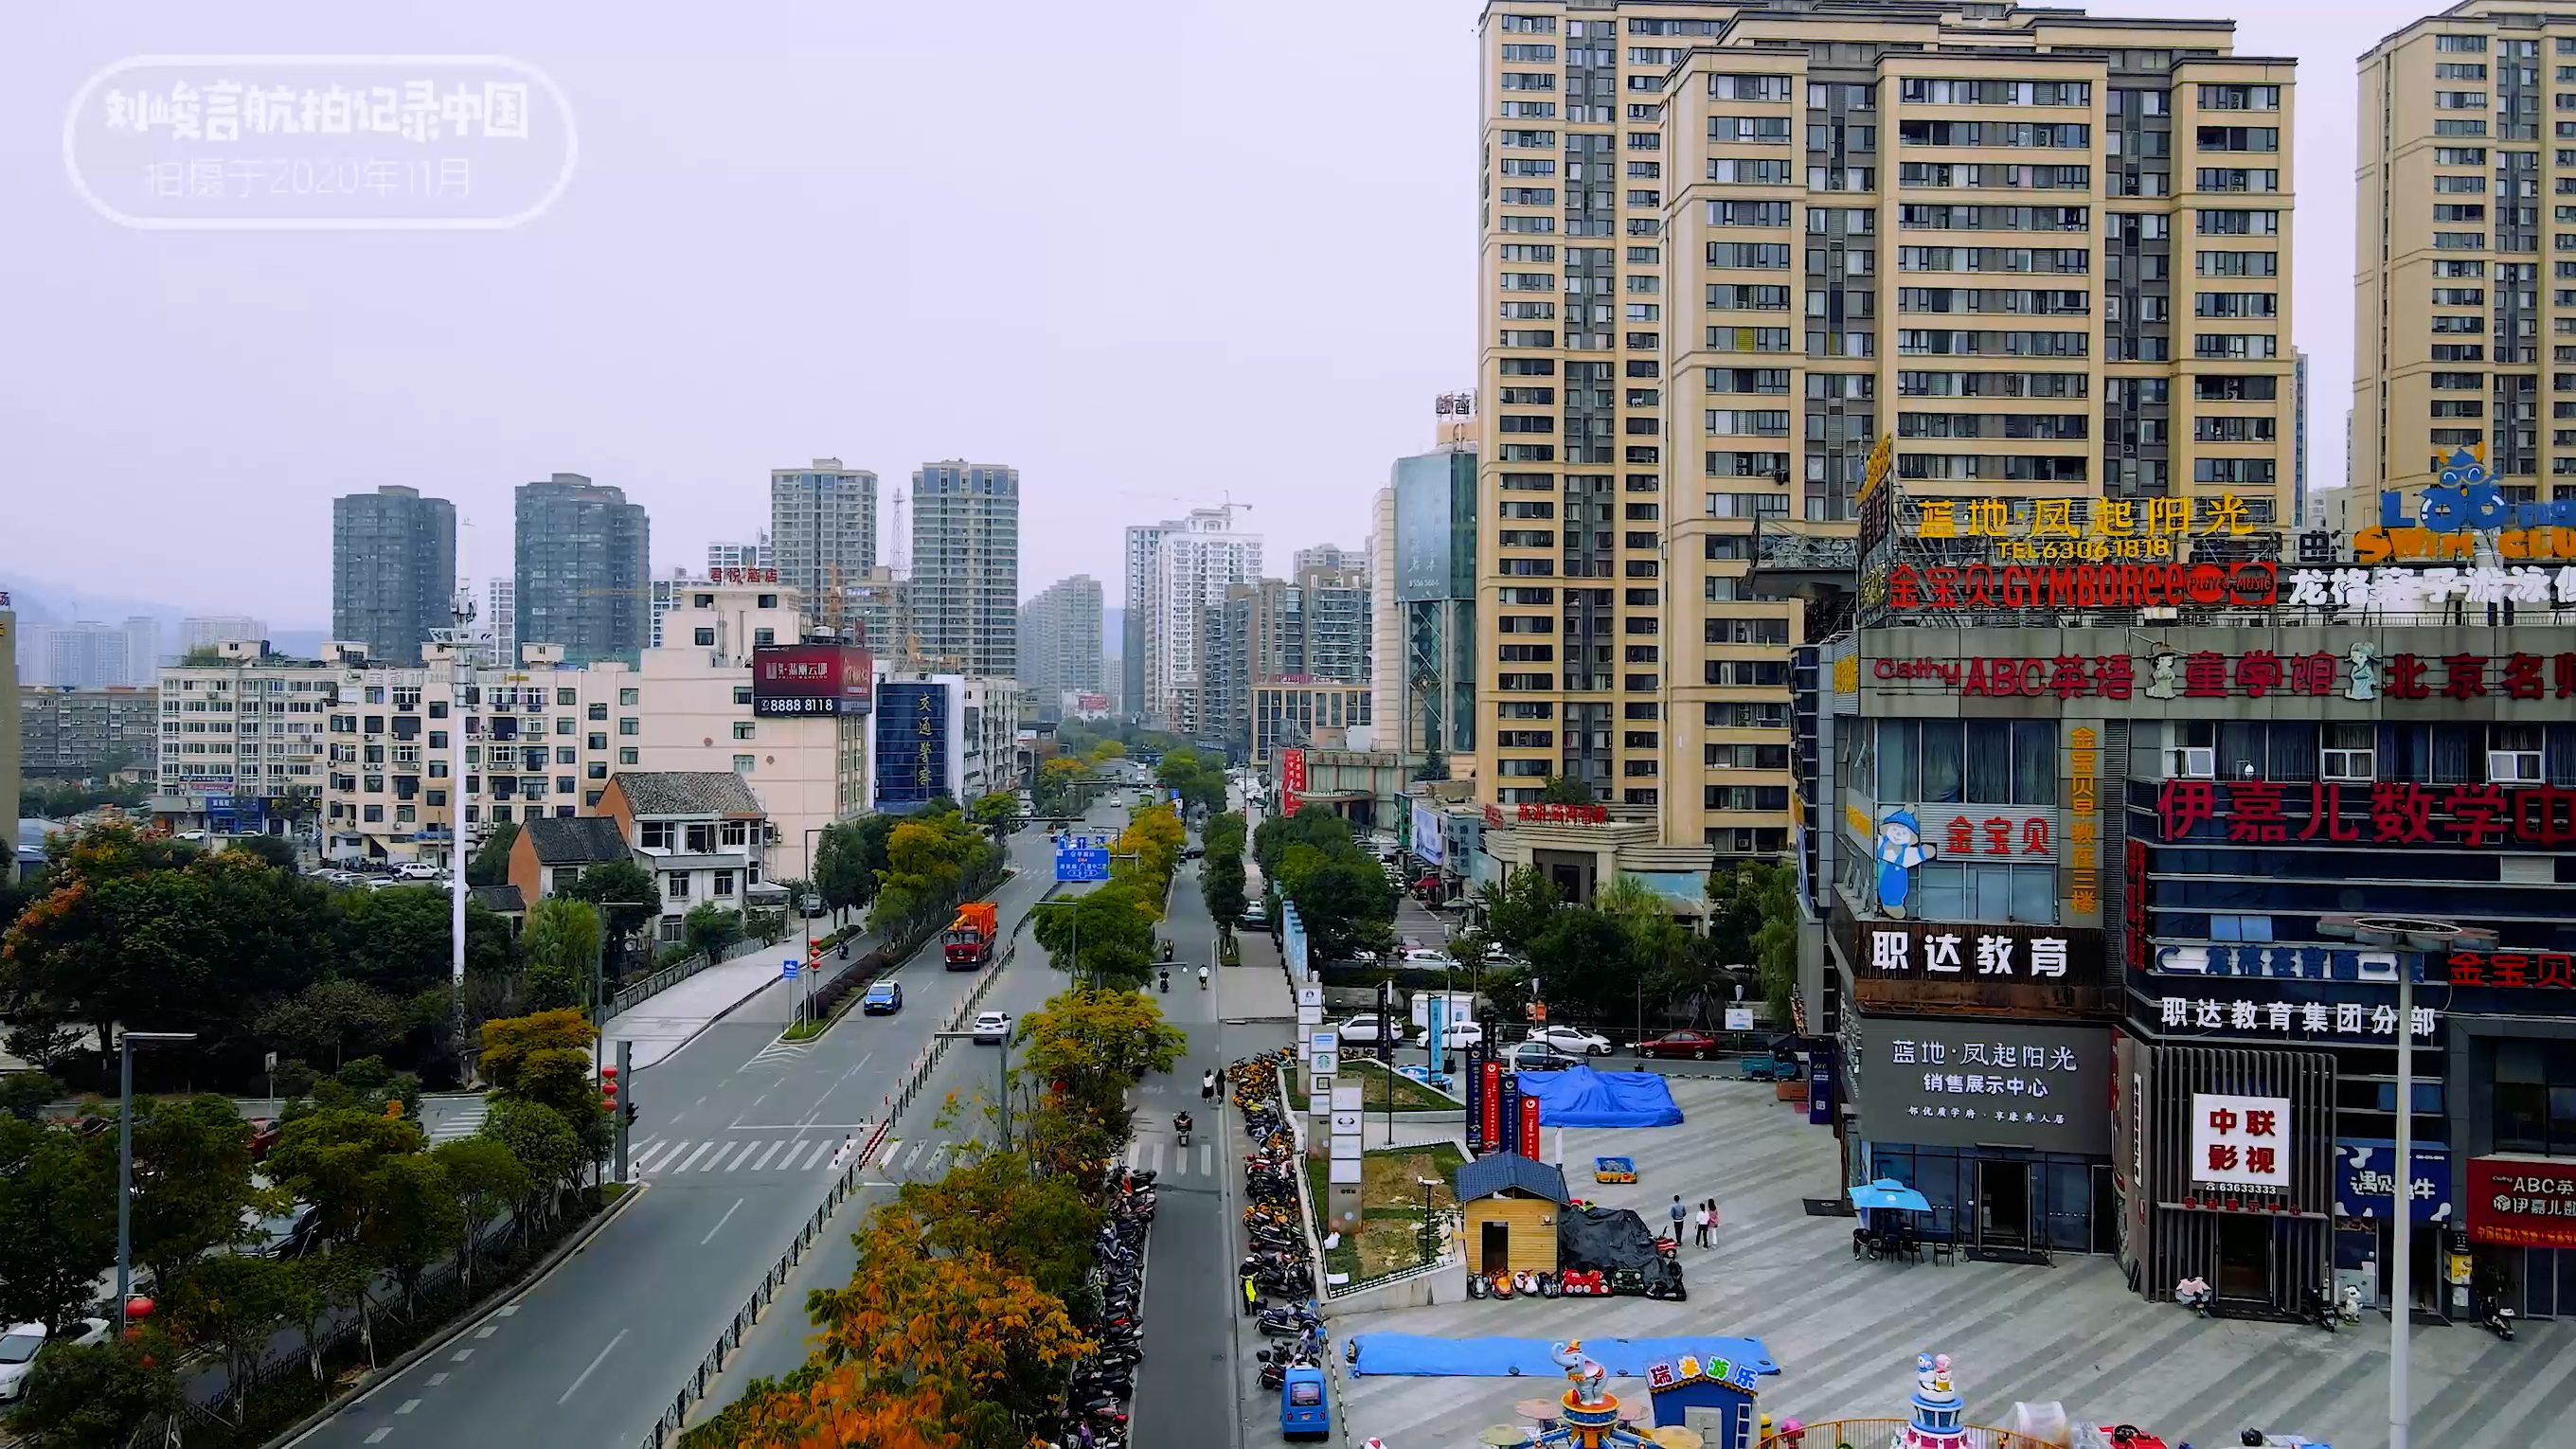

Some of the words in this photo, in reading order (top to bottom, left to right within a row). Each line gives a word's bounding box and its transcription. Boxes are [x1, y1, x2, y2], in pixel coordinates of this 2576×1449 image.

[1889, 563, 1996, 608] 金宝贝
[2184, 650, 2337, 700] 童学馆
[770, 698, 801, 712] 8888
[804, 698, 833, 712] 8118
[918, 691, 933, 786] 交通警察
[1946, 815, 2049, 855] 金宝贝
[2069, 726, 2097, 916] 金宝贝早教在三楼
[1871, 931, 2068, 977] 职达教育
[2447, 952, 2574, 989] 金宝贝
[2161, 996, 2436, 1037] 职达教育集团分部
[1892, 1039, 2078, 1072] 蓝地·凤起阳光
[1923, 1073, 2049, 1098] 销售展示中心
[2209, 1108, 2276, 1136] 中联
[2209, 1144, 2276, 1173] 影视
[2350, 1170, 2436, 1200] 遇见牛
